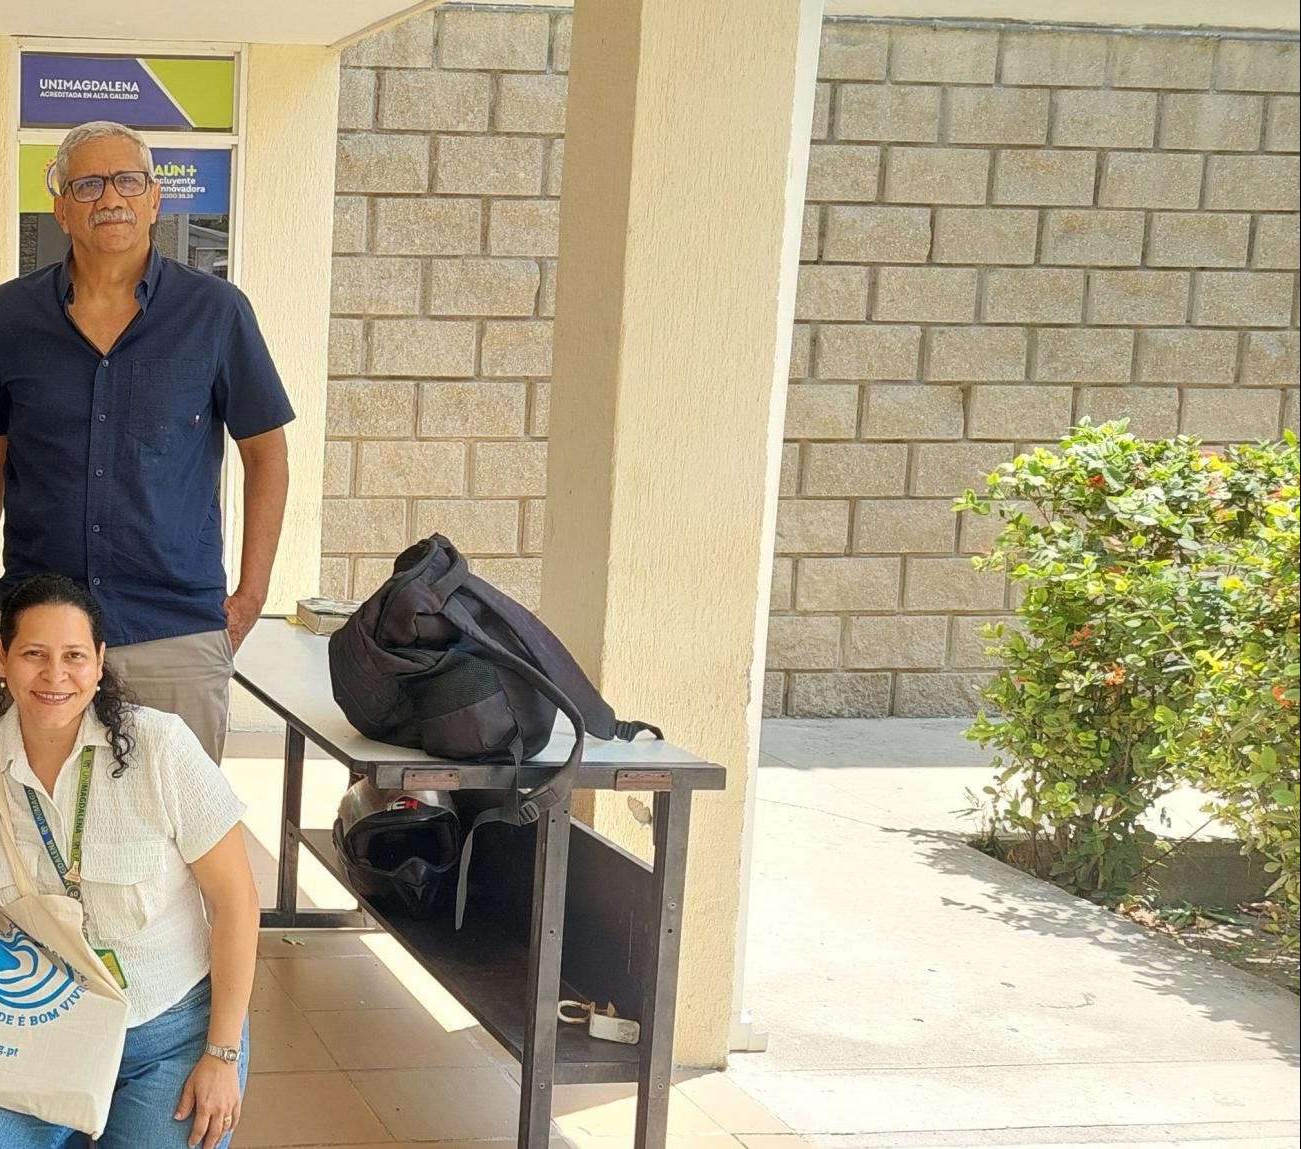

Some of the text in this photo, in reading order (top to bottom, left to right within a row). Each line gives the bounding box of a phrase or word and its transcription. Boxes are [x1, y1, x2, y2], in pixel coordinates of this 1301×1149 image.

[39, 78, 140, 92] UNIMAGDALENA
[18, 1015, 26, 1027] É
[30, 1008, 60, 1027] BOM
